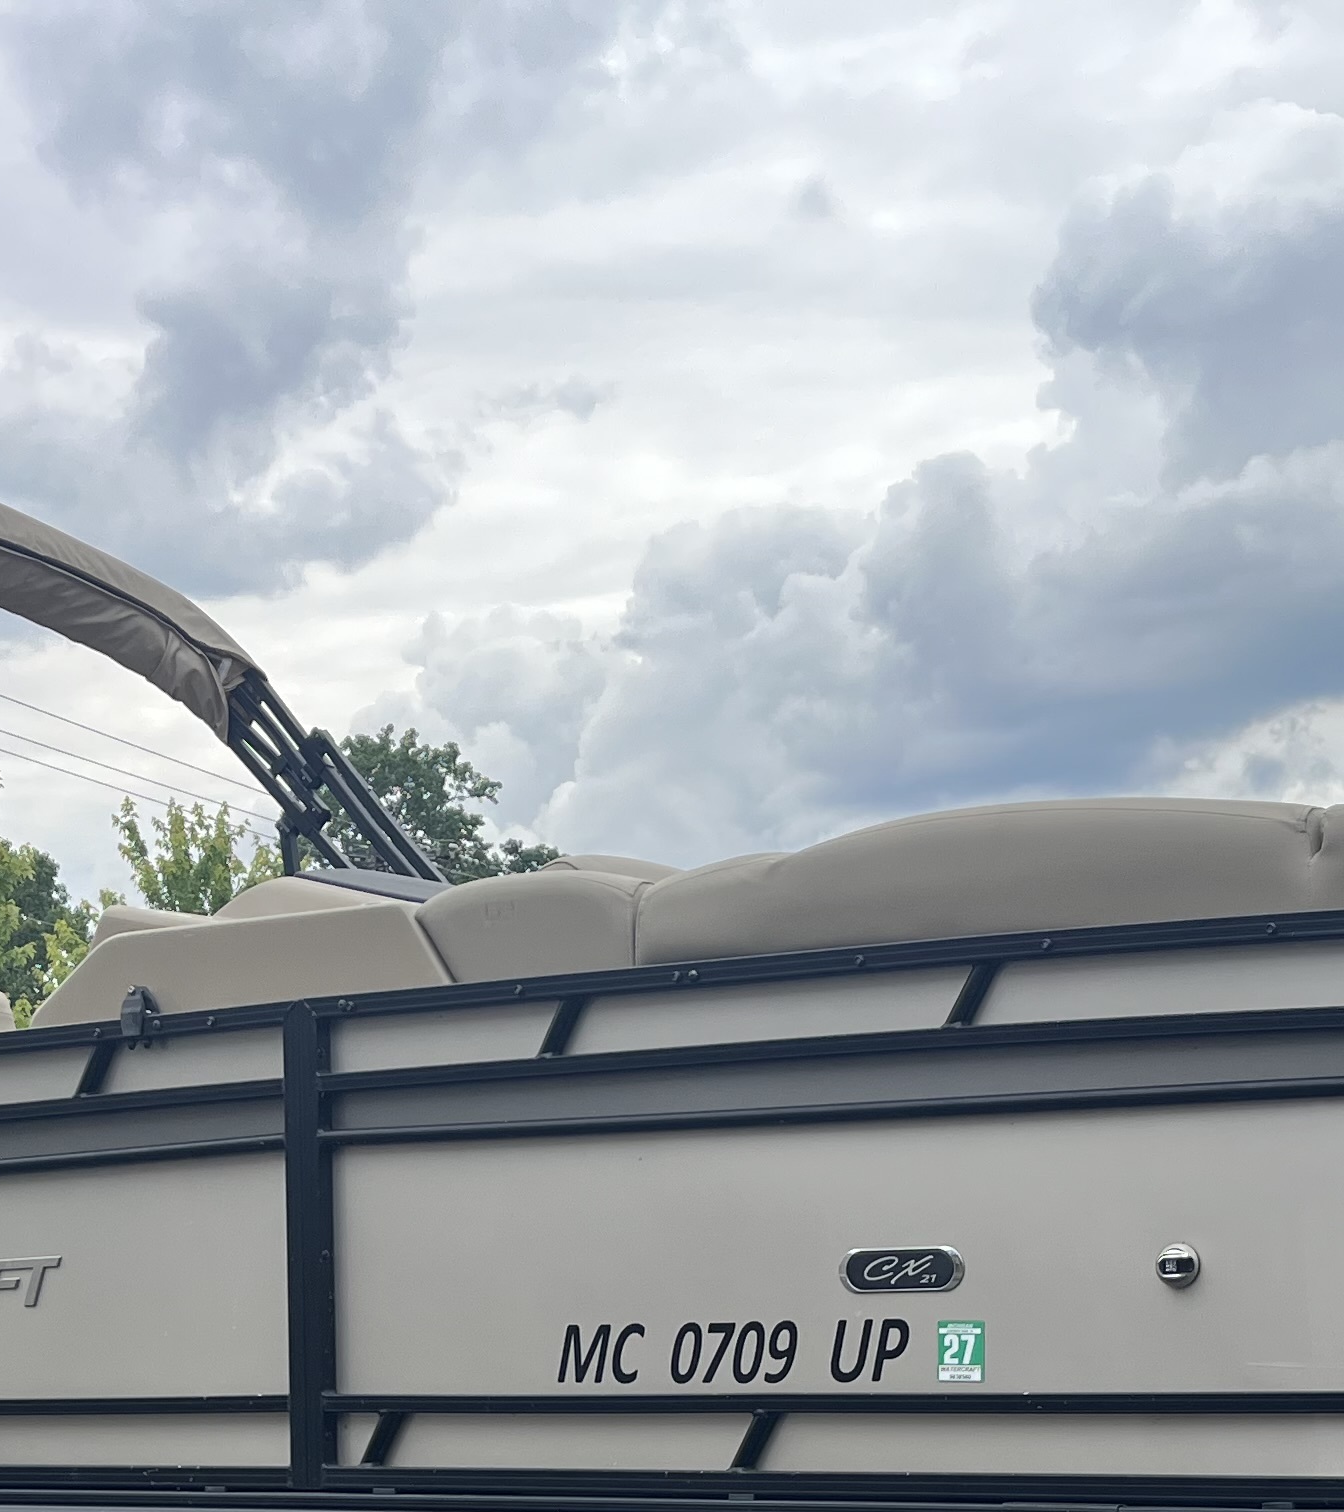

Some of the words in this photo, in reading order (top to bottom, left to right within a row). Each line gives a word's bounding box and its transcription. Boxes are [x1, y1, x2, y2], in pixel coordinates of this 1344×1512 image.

[863, 1254, 934, 1285] CX
[919, 1273, 937, 1284] 21
[557, 1323, 646, 1384] MC
[669, 1320, 798, 1384] 0709
[830, 1318, 910, 1383] UP
[943, 1334, 976, 1365] 27
